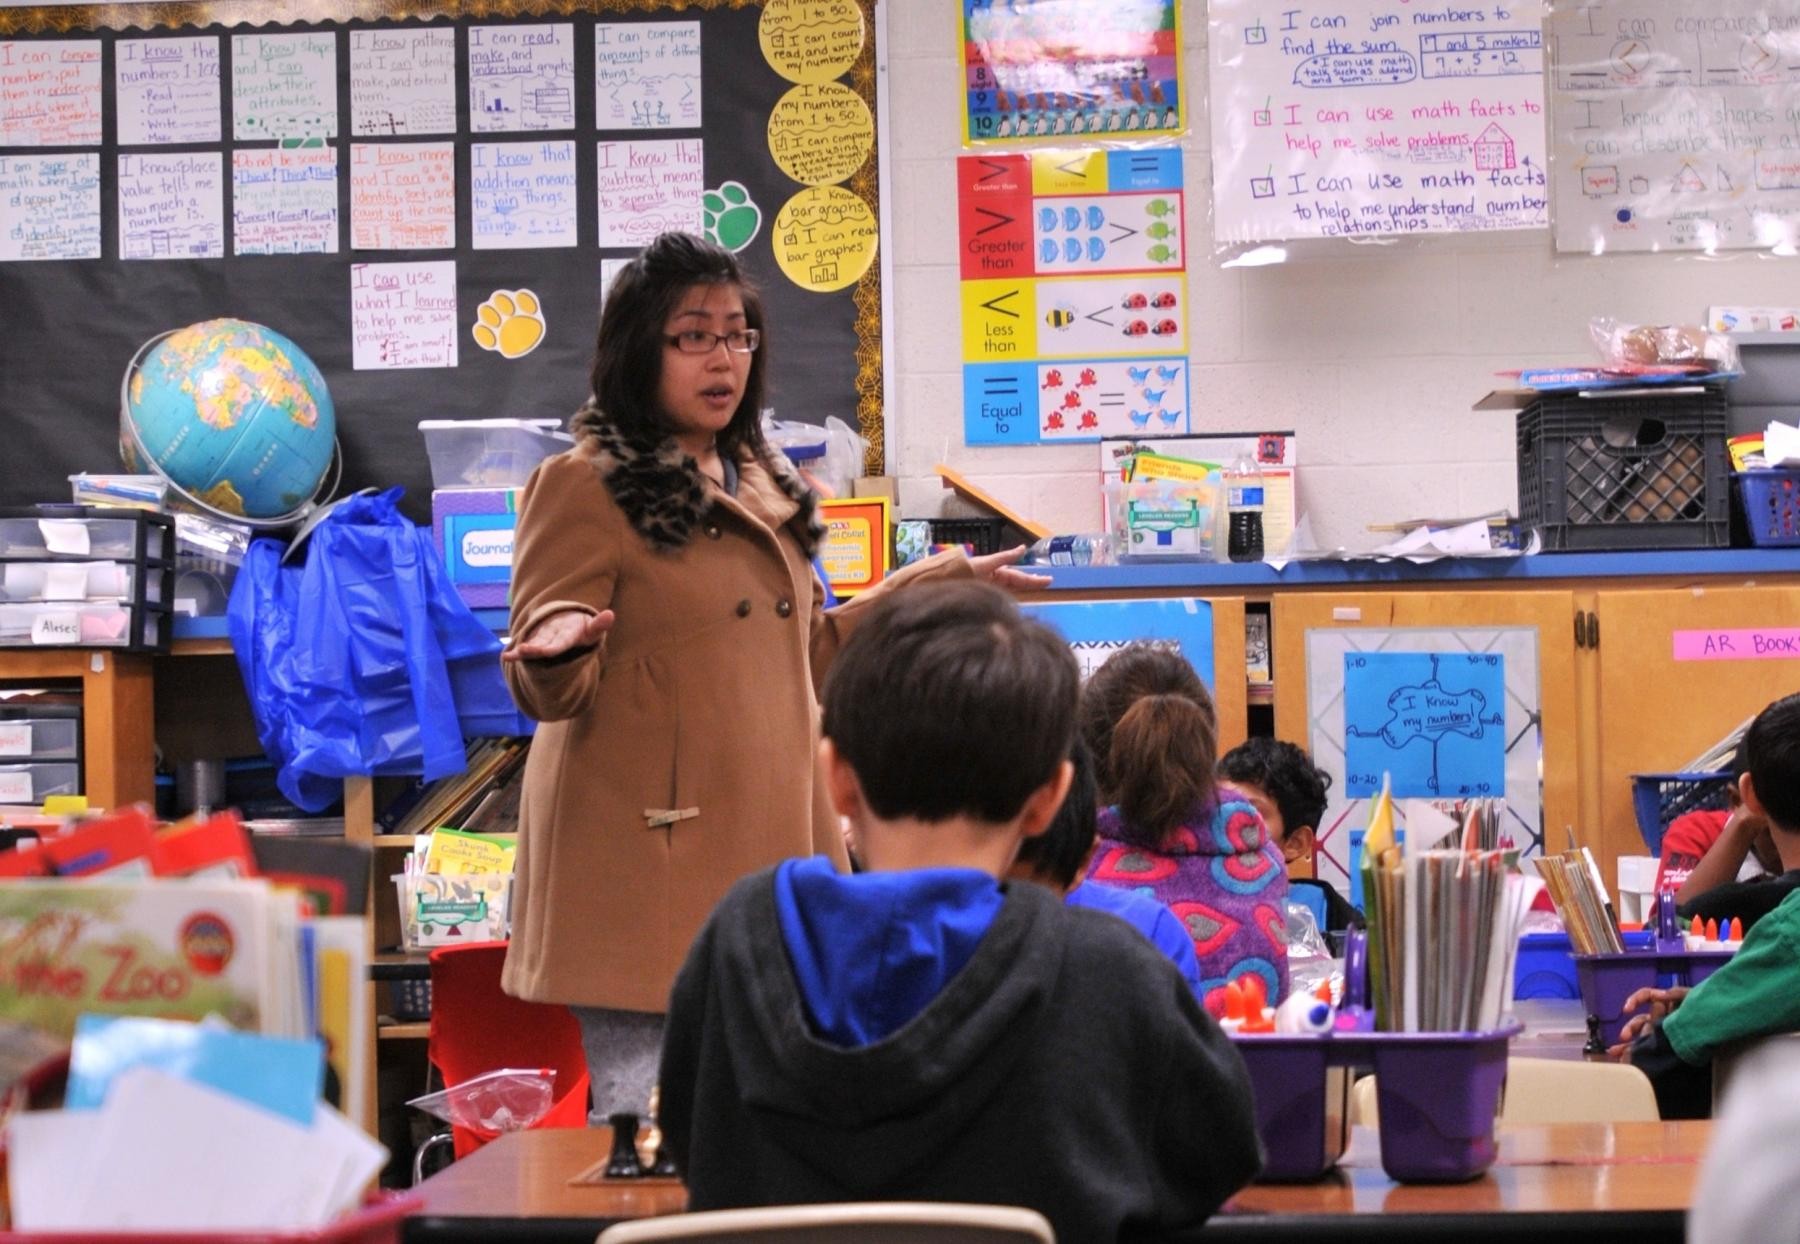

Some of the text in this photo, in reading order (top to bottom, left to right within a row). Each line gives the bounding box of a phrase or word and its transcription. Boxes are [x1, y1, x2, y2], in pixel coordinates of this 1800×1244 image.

[763, 9, 826, 25] from to
[1280, 6, 1510, 31] I can join numbers to
[1577, 7, 1602, 35] I
[1618, 18, 1656, 34] can
[371, 32, 406, 51] know
[471, 28, 517, 46] I can
[598, 26, 697, 45] I can compare
[804, 34, 826, 44] can
[1446, 33, 1468, 51] and
[1476, 36, 1486, 50] 5
[1492, 34, 1528, 48] makes
[124, 41, 217, 62] I know the
[511, 47, 532, 60] and
[805, 40, 860, 57] and write
[1280, 37, 1315, 56] find
[1325, 39, 1354, 54] the
[235, 59, 257, 75] and
[352, 56, 413, 71] and can
[786, 61, 802, 75] my
[1321, 57, 1329, 67] I
[1381, 54, 1411, 65] math
[1472, 53, 1481, 66] 5
[121, 64, 179, 83] numbers
[977, 66, 986, 80] 8
[1303, 68, 1330, 79] talk
[1333, 66, 1357, 75] such
[1360, 67, 1373, 75] as
[799, 83, 815, 97] I
[976, 91, 987, 105] 9
[781, 99, 860, 114] my numbers
[1284, 98, 1541, 125] I can use math facts to
[773, 113, 835, 127] from to
[976, 115, 993, 130] 10
[1575, 101, 1602, 129] I
[1714, 97, 1774, 134] shapes
[808, 137, 830, 147] can
[1285, 132, 1322, 159] help
[1333, 138, 1356, 149] me
[1366, 131, 1400, 148] solve
[1585, 138, 1620, 154] can
[352, 145, 415, 166] I know
[473, 143, 571, 168] I know that
[600, 140, 701, 170] I know that
[120, 155, 134, 177] I
[119, 175, 214, 198] value tells me
[352, 171, 377, 186] and
[474, 170, 530, 189] addition
[1288, 168, 1546, 195] I can use math facts
[149, 193, 184, 213] much
[808, 188, 821, 201] I
[790, 205, 816, 217] bar
[1293, 194, 1548, 223] to help me understand number
[129, 210, 176, 230] number
[802, 227, 845, 244] I can
[967, 239, 1025, 254] Greater
[786, 251, 810, 263] bar
[981, 256, 1014, 269] than
[353, 263, 437, 291] I can use
[355, 293, 391, 311] what
[371, 312, 425, 330] help me
[986, 321, 1014, 336] Less
[984, 339, 1016, 352] than
[981, 401, 1022, 421] Equal
[995, 421, 1010, 434] to
[1704, 634, 1800, 655] AR Book
[1346, 658, 1366, 671] 1-10
[1402, 696, 1416, 711] I
[1403, 716, 1422, 732] my
[98, 946, 190, 1002] Zoo
